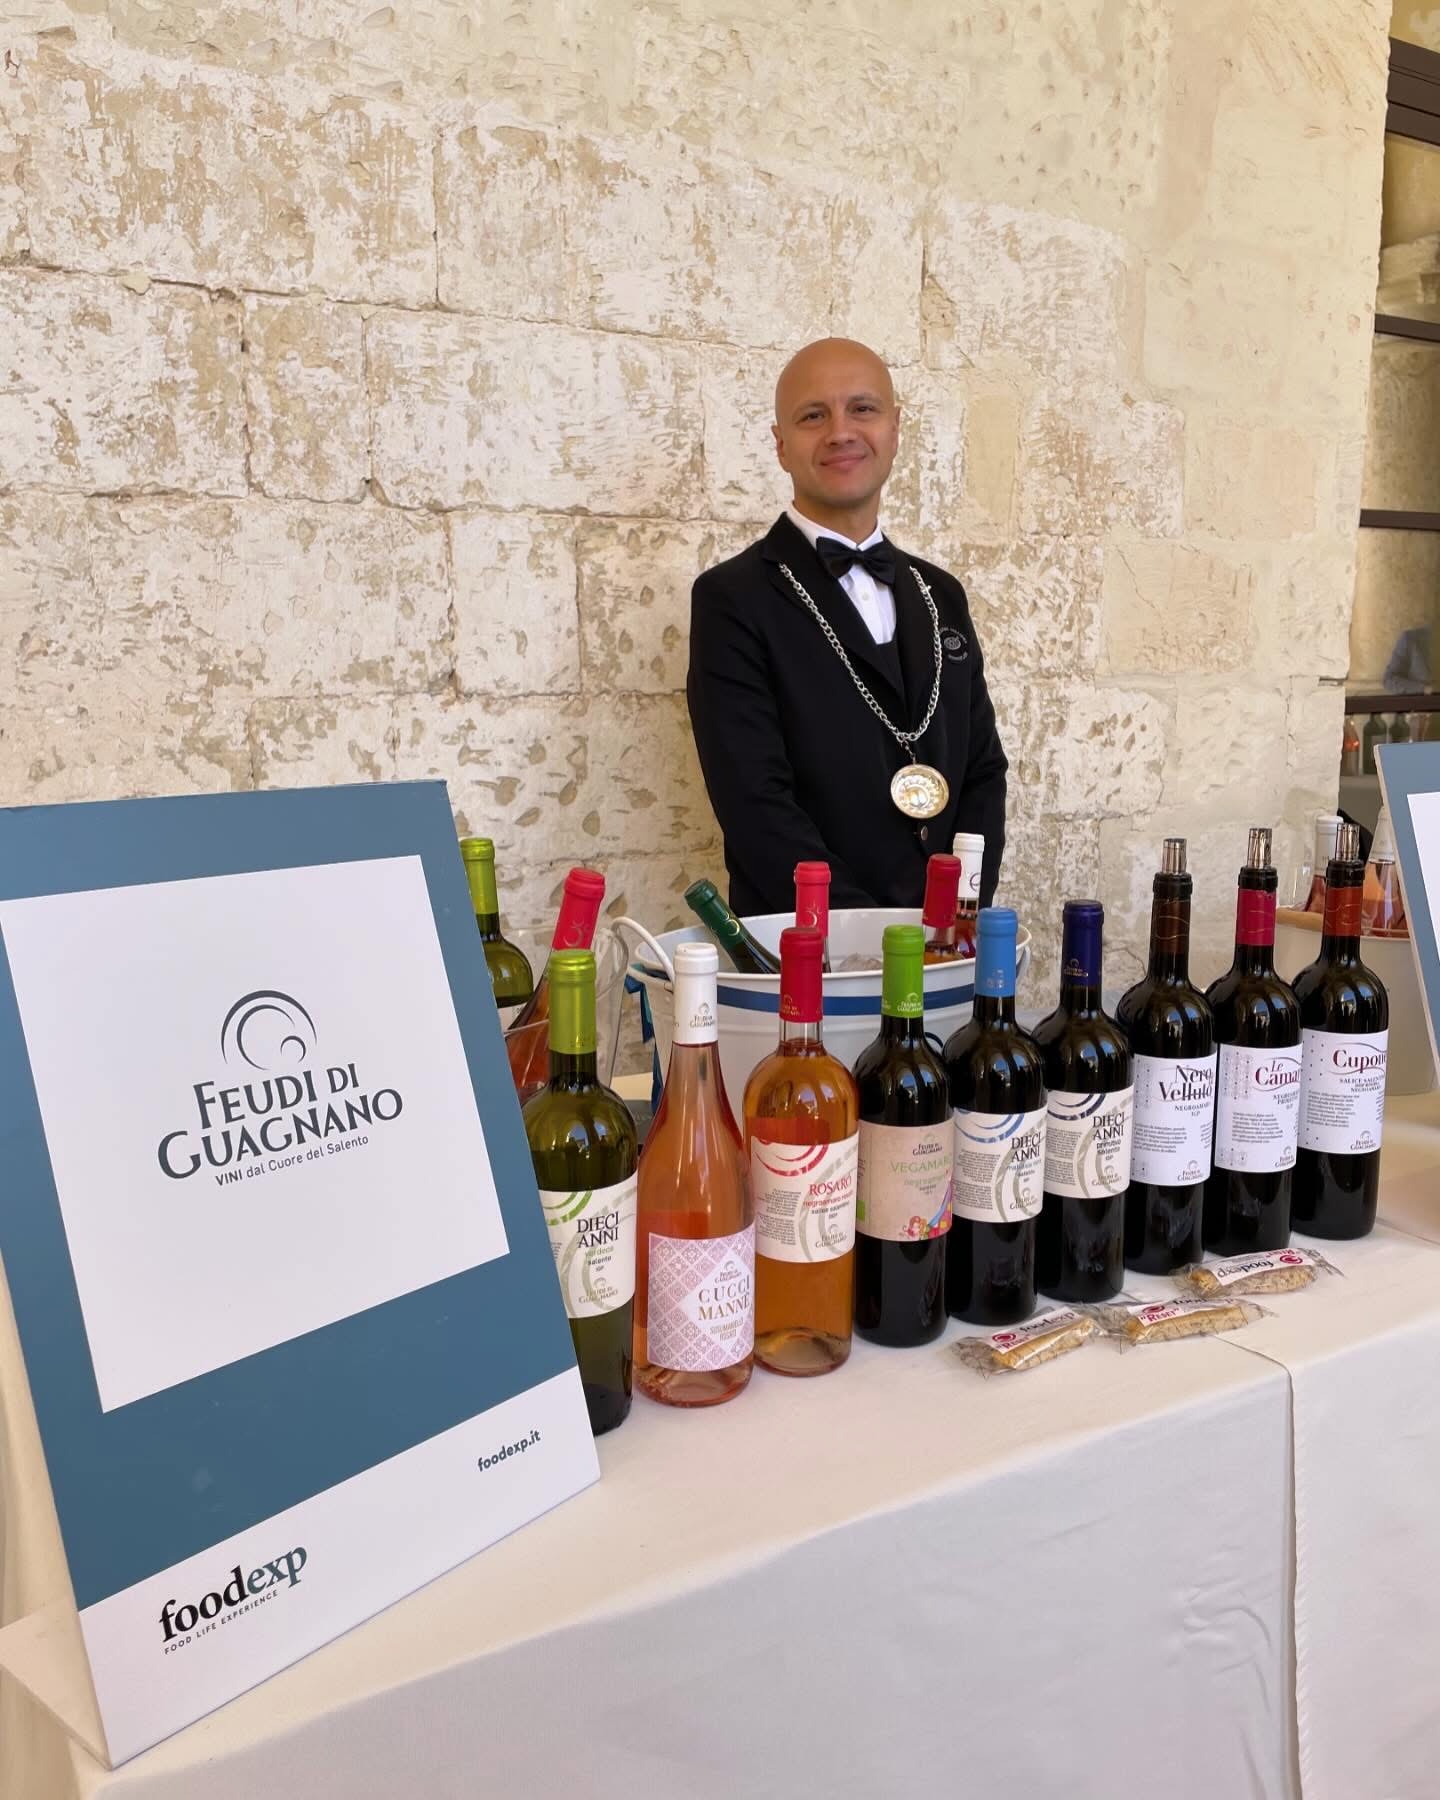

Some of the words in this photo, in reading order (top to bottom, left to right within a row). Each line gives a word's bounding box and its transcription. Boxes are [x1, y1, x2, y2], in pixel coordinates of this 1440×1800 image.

[1175, 1064, 1211, 1083] Nero
[1271, 1060, 1283, 1072] Le
[193, 1070, 318, 1129] FEUDI
[326, 1063, 360, 1094] DI
[1159, 1082, 1212, 1101] Velluto
[1093, 1112, 1125, 1128] DIECI
[157, 1088, 403, 1179] GUAGNANO
[1012, 1132, 1041, 1149] DIECI
[1093, 1125, 1124, 1140] ANNI
[215, 1169, 243, 1186] VINI
[246, 1164, 266, 1178] dal
[268, 1154, 304, 1171] Cuore
[306, 1148, 324, 1161] del
[327, 1136, 369, 1154] Salento
[1012, 1145, 1040, 1162] ANNI
[577, 1211, 619, 1233] DIECI
[577, 1228, 618, 1248] ANNI
[698, 1274, 750, 1302] CUCCI
[477, 1430, 541, 1472] foodexp.it
[158, 1546, 307, 1643] foodexp
[164, 1636, 192, 1654] FOOD
[196, 1622, 217, 1639] LIFE
[221, 1590, 278, 1625] EXPERIENCE
